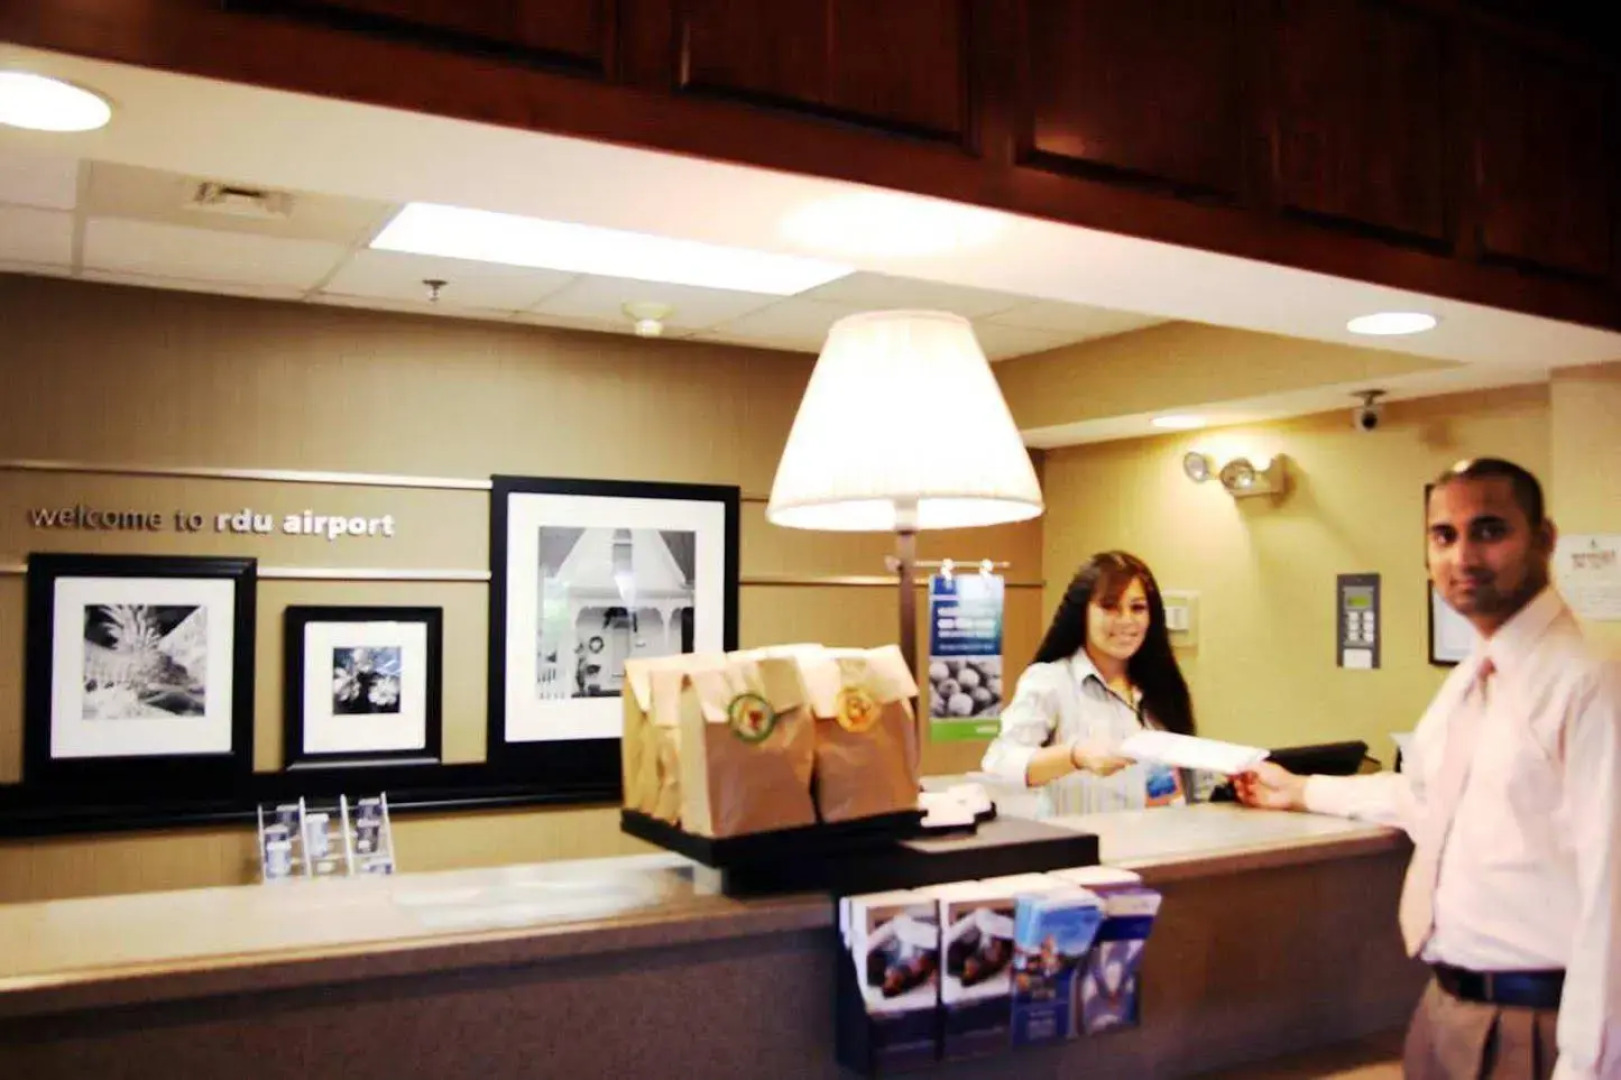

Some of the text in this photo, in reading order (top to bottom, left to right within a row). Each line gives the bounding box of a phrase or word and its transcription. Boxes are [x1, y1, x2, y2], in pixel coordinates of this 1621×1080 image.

[29, 504, 395, 540] welcome to rdu airport
